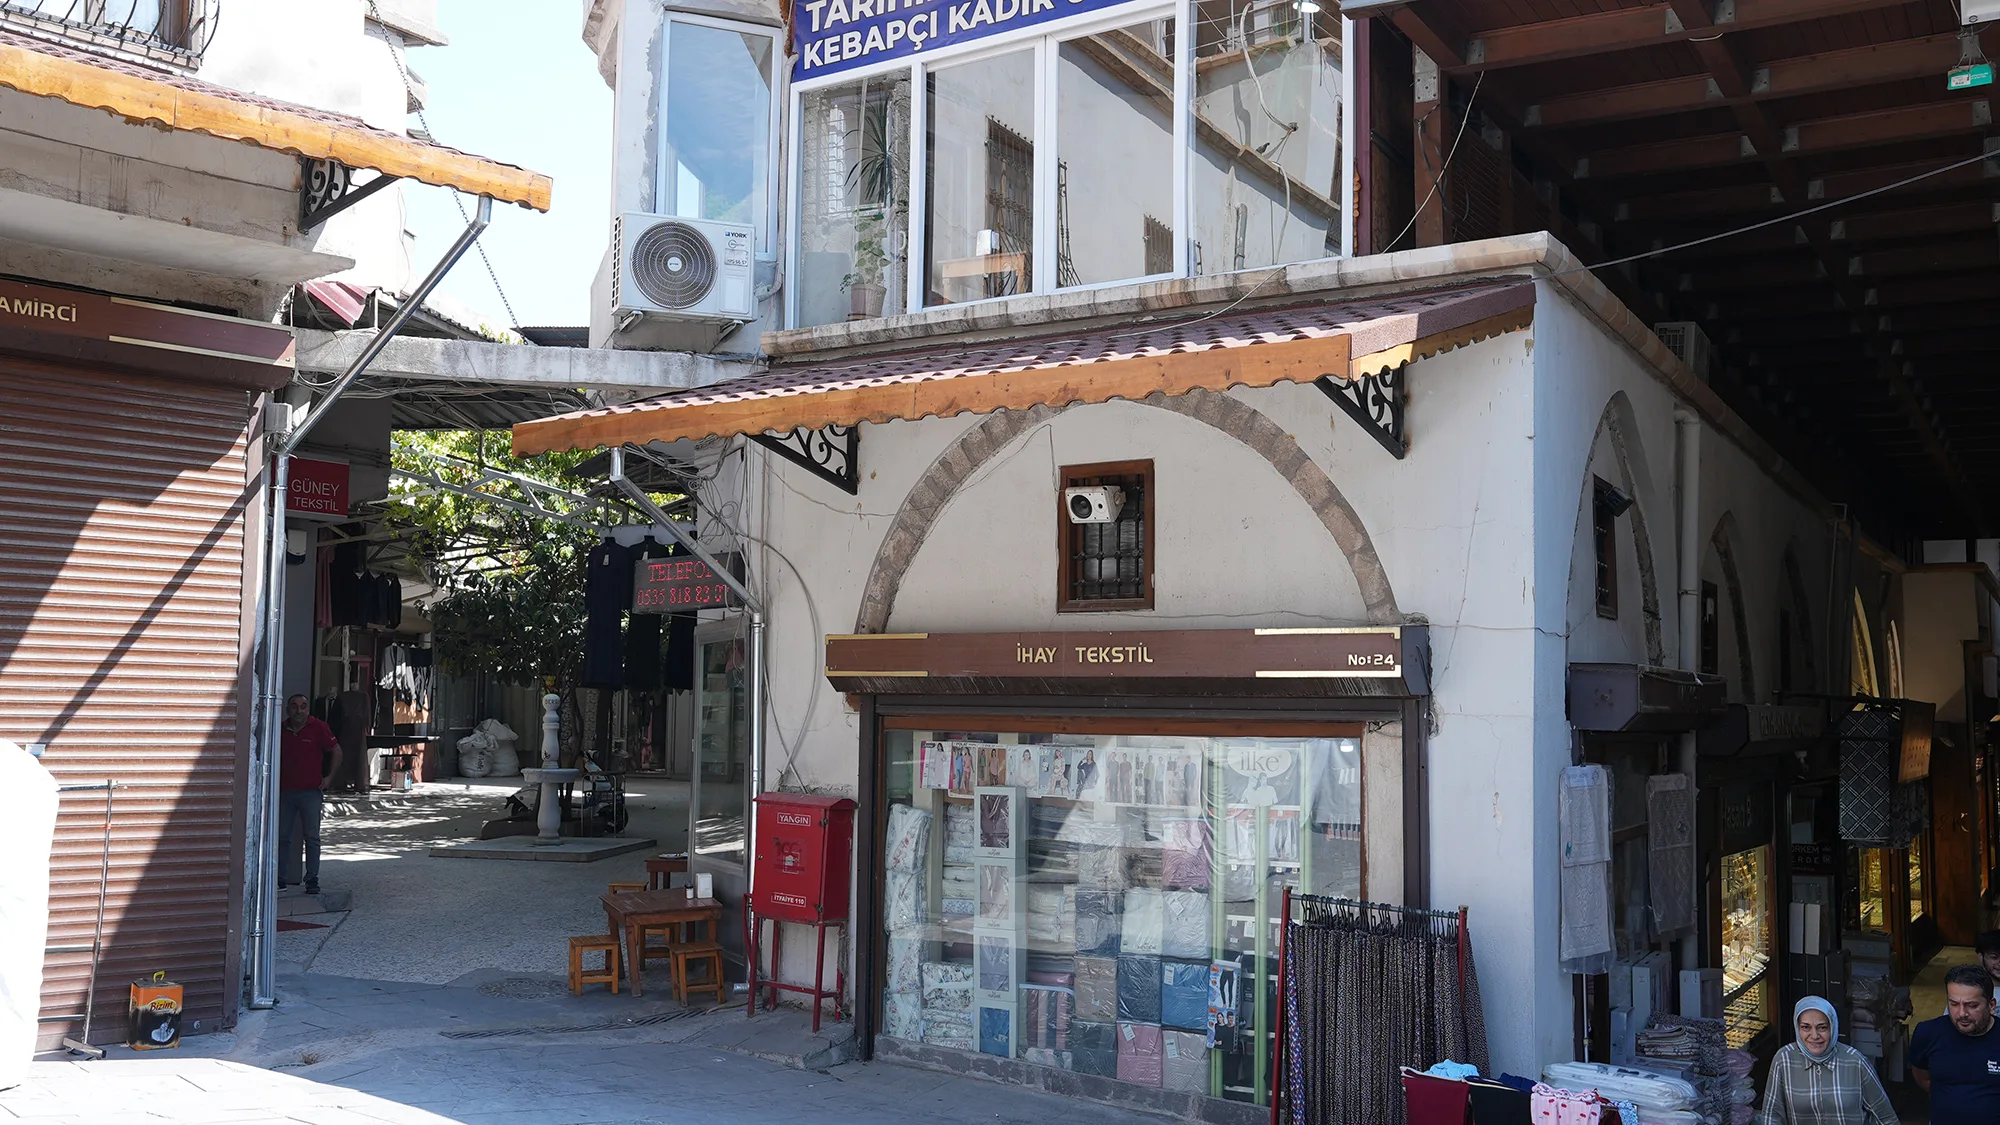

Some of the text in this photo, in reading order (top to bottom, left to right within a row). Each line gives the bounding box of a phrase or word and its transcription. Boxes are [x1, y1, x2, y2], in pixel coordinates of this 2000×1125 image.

[804, 10, 938, 70] KEBAPÇI
[292, 478, 340, 496] GÜNEY
[294, 497, 339, 511] TEKSTİL
[669, 586, 691, 604] 818
[1016, 642, 1154, 663] İHAY TEKSTİL
[1240, 751, 1279, 771] ilke
[780, 814, 809, 825] YANGIN
[795, 897, 805, 905] 110
